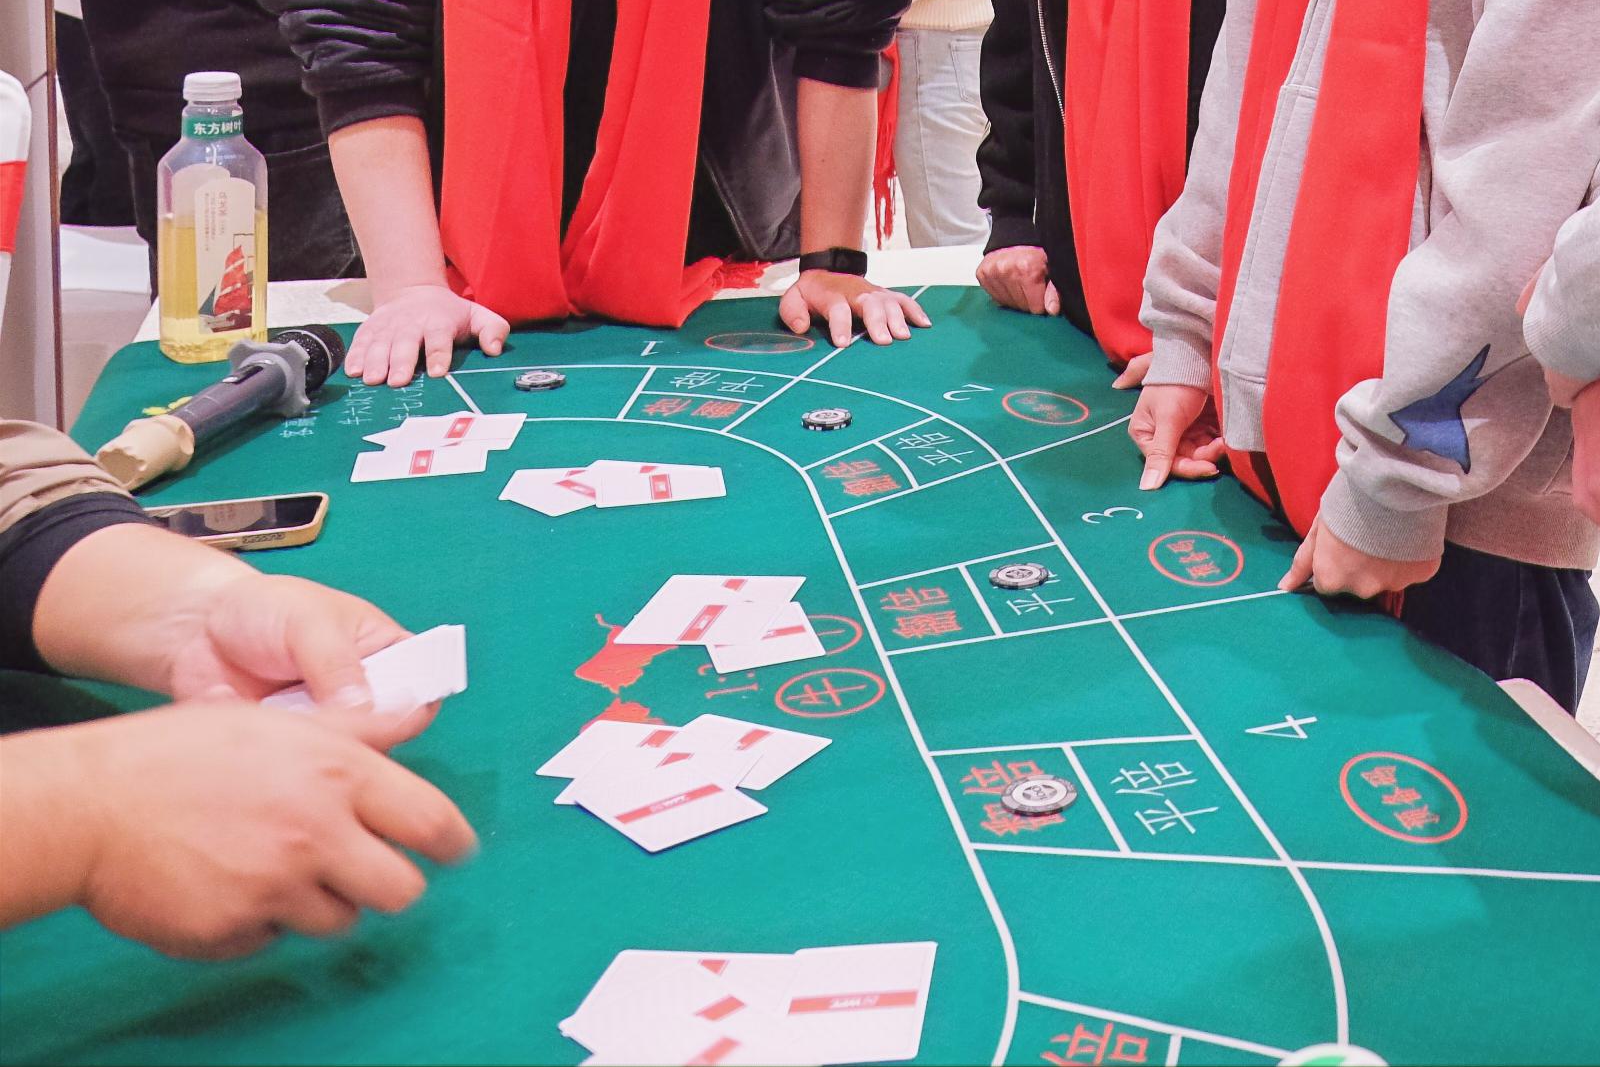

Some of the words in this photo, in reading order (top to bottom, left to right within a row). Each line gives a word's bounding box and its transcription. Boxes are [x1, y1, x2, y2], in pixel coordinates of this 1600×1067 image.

[194, 120, 241, 135] 东方树叶
[1110, 761, 1219, 836] 平倍
